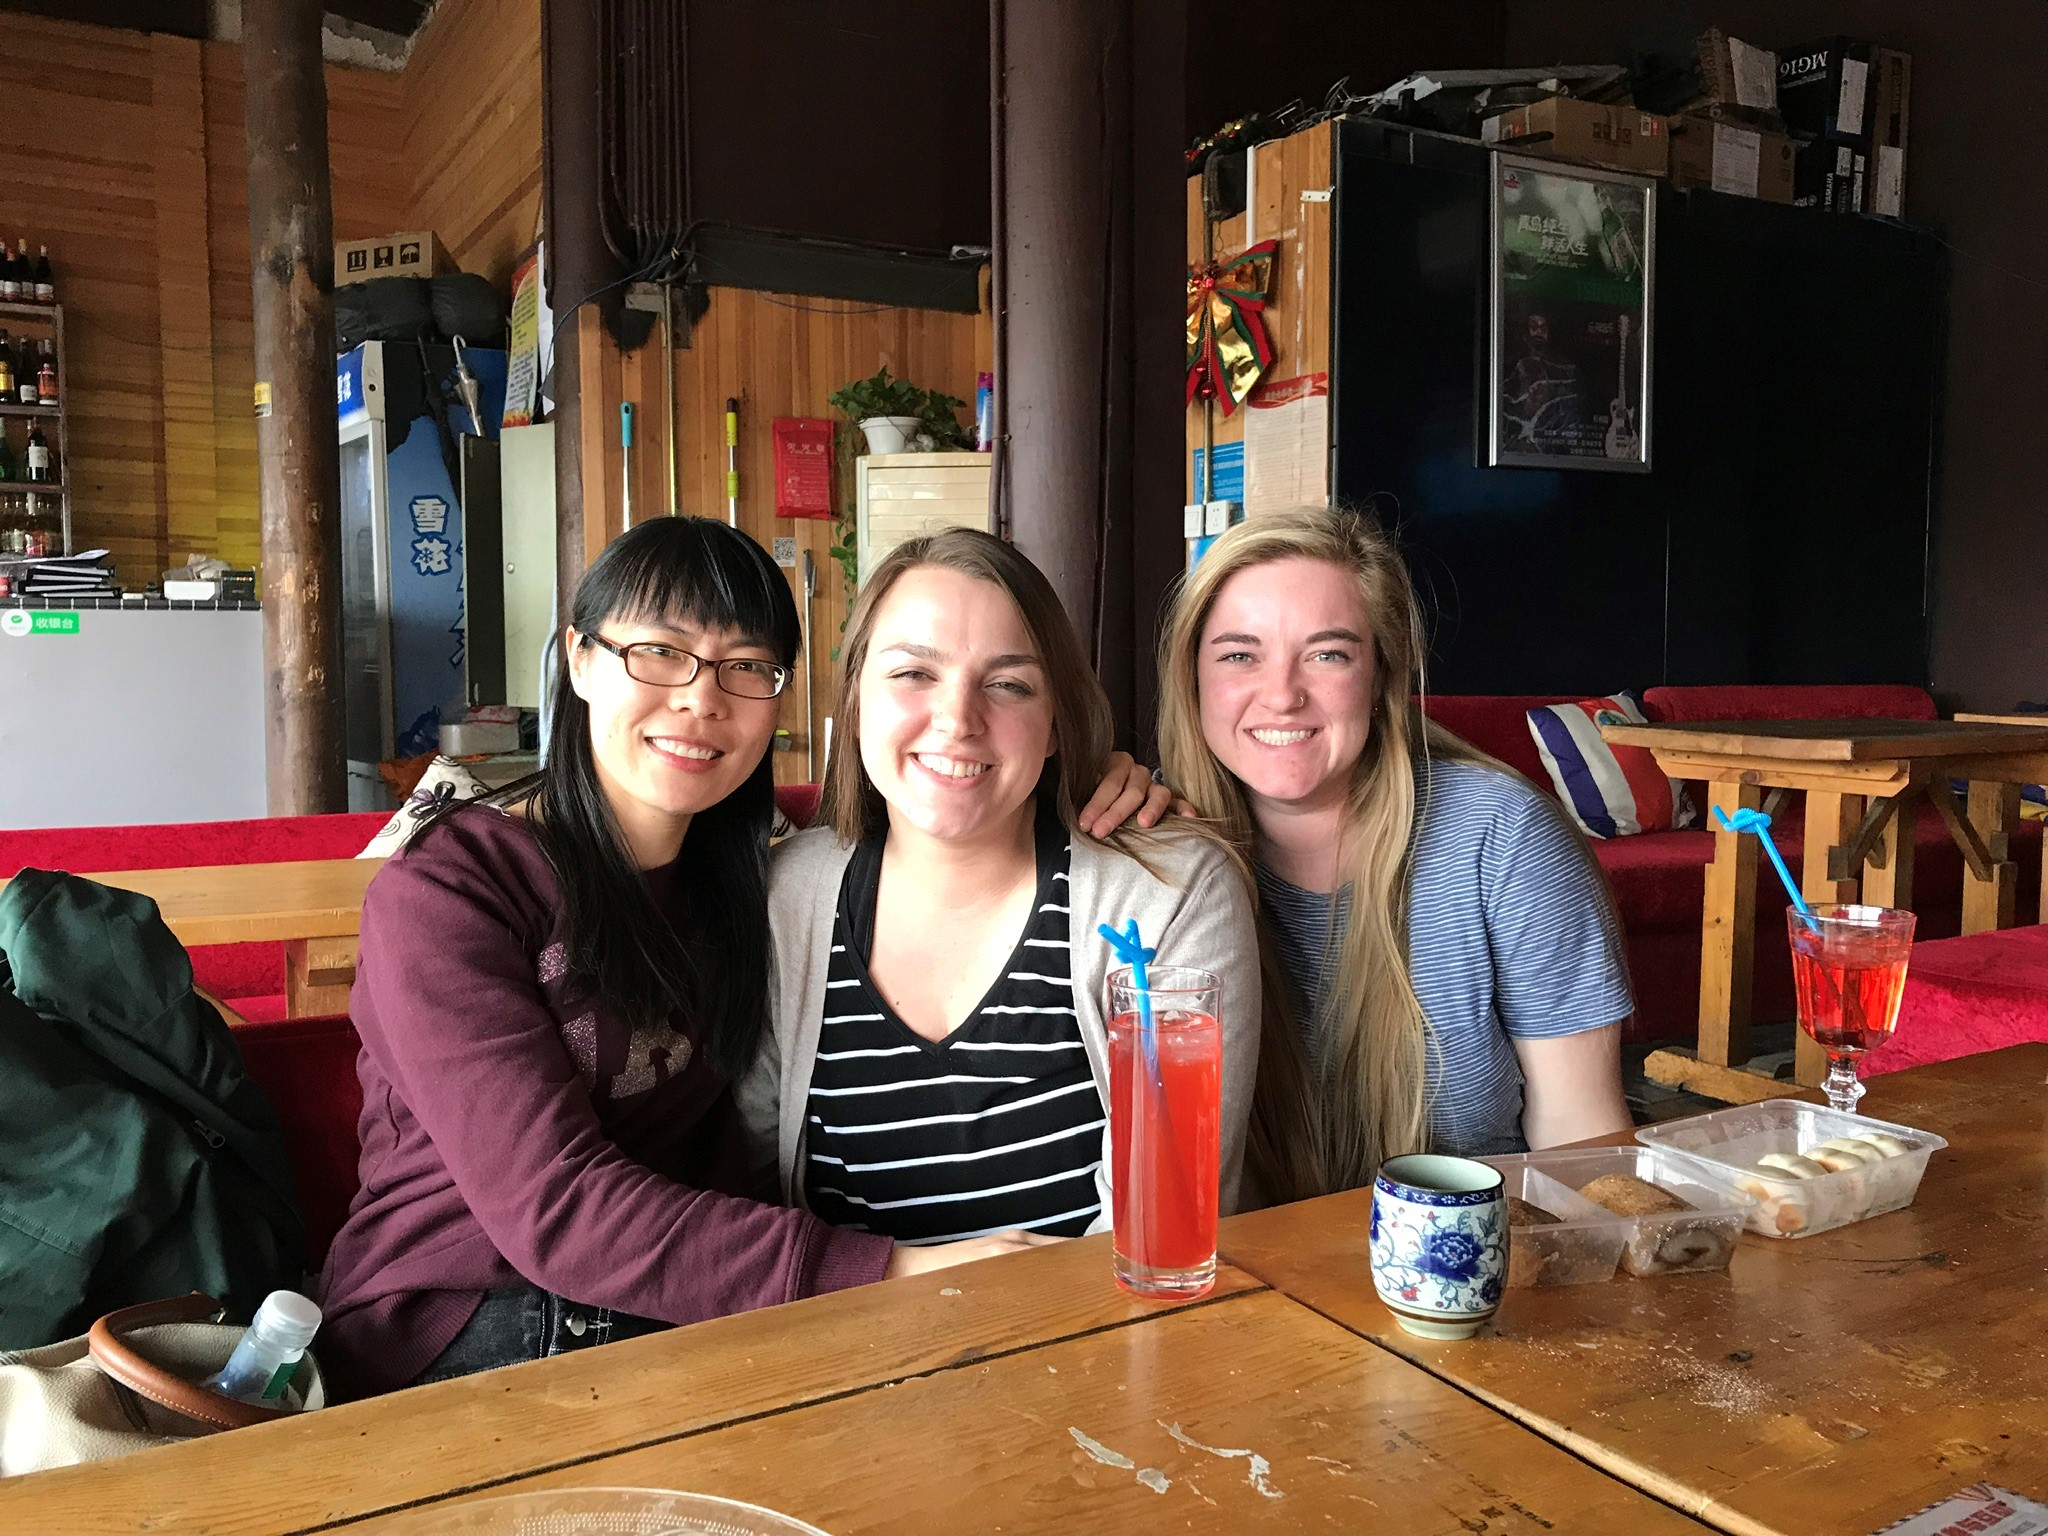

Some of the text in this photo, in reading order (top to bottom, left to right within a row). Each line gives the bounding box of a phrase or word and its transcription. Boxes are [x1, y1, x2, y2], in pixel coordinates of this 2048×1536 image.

[1780, 50, 1829, 77] MG16
[1824, 172, 1834, 206] YAMAHA
[410, 495, 452, 576] 雪花
[35, 617, 74, 629] 收银台
